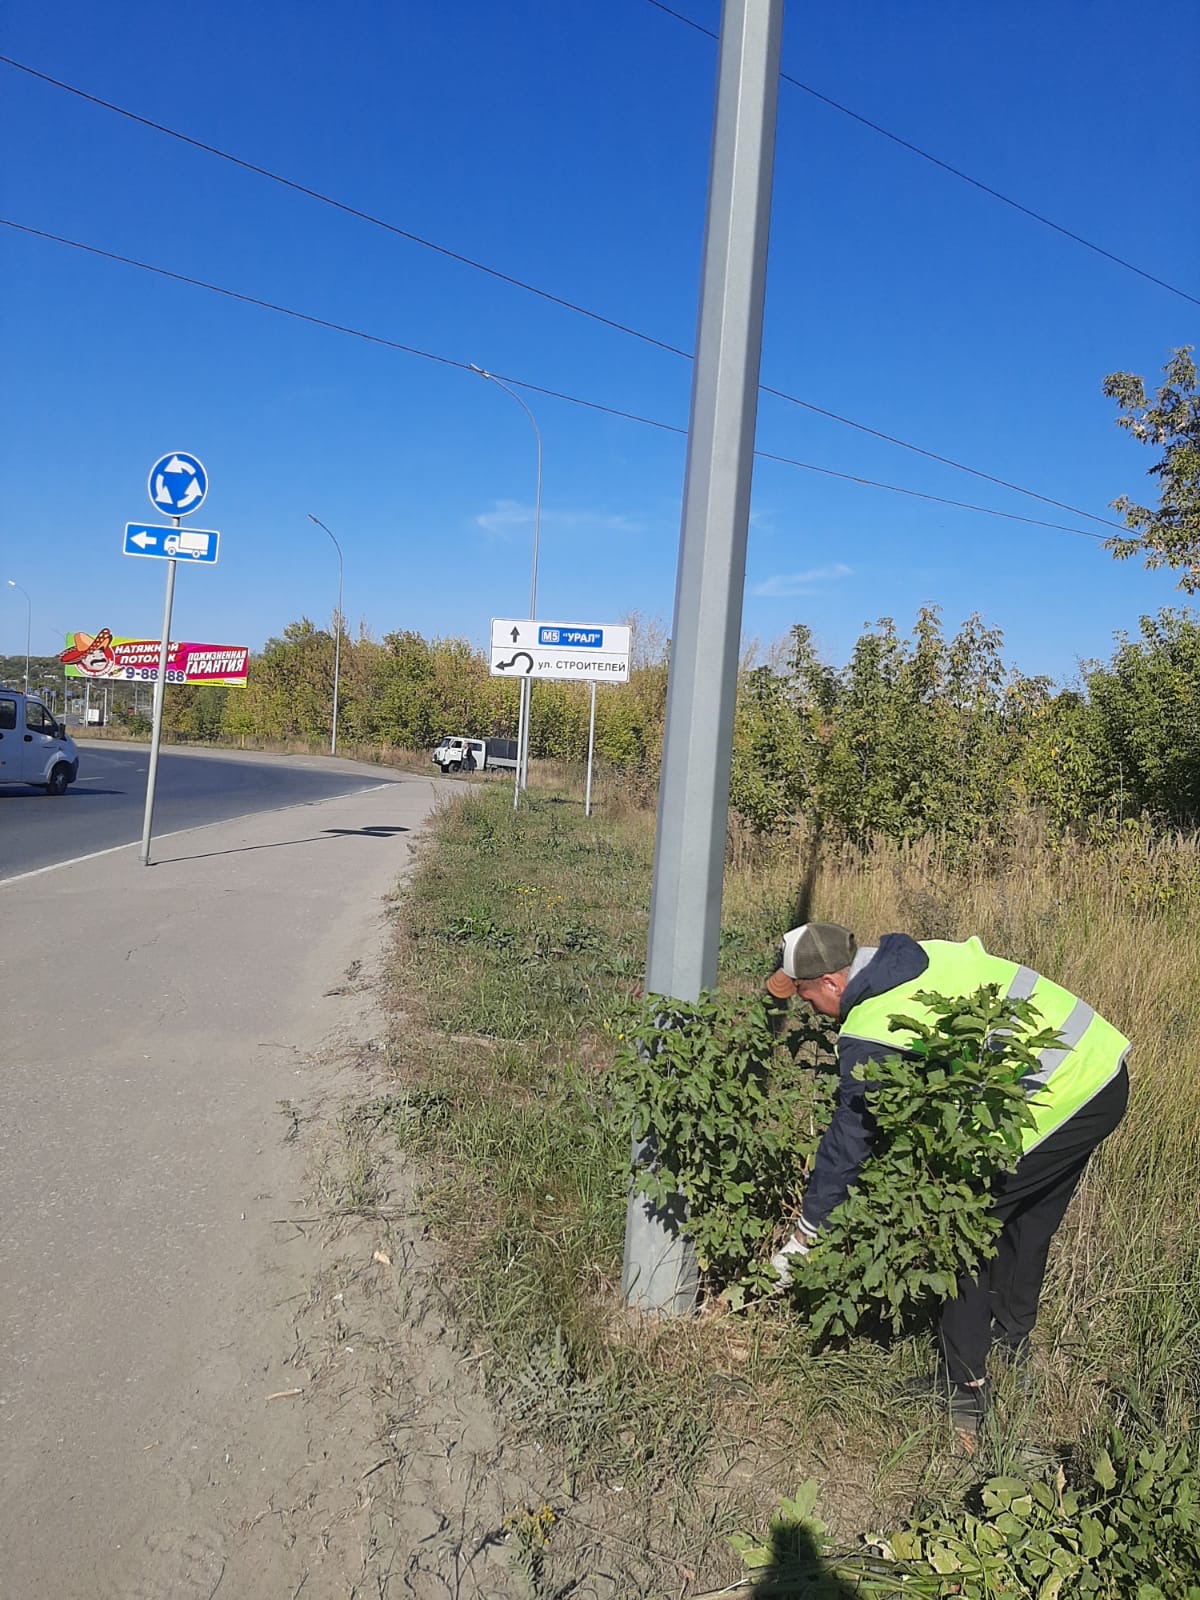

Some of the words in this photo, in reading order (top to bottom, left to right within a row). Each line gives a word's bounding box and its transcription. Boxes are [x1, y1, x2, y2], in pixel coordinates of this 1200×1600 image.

[543, 631, 559, 642] М5
[563, 632, 601, 643] "УРАЛ"
[115, 643, 179, 653] НАТЯЖНЙ
[120, 653, 176, 664] ПОТОЛК
[188, 651, 247, 661] ПОЖИЗНЕННАЯ
[186, 659, 245, 674] ГАРАНТИЯ
[538, 661, 553, 670] ул.
[556, 660, 627, 672] СТРОИТЕЛЕЙ
[126, 666, 184, 682] 9-8888
